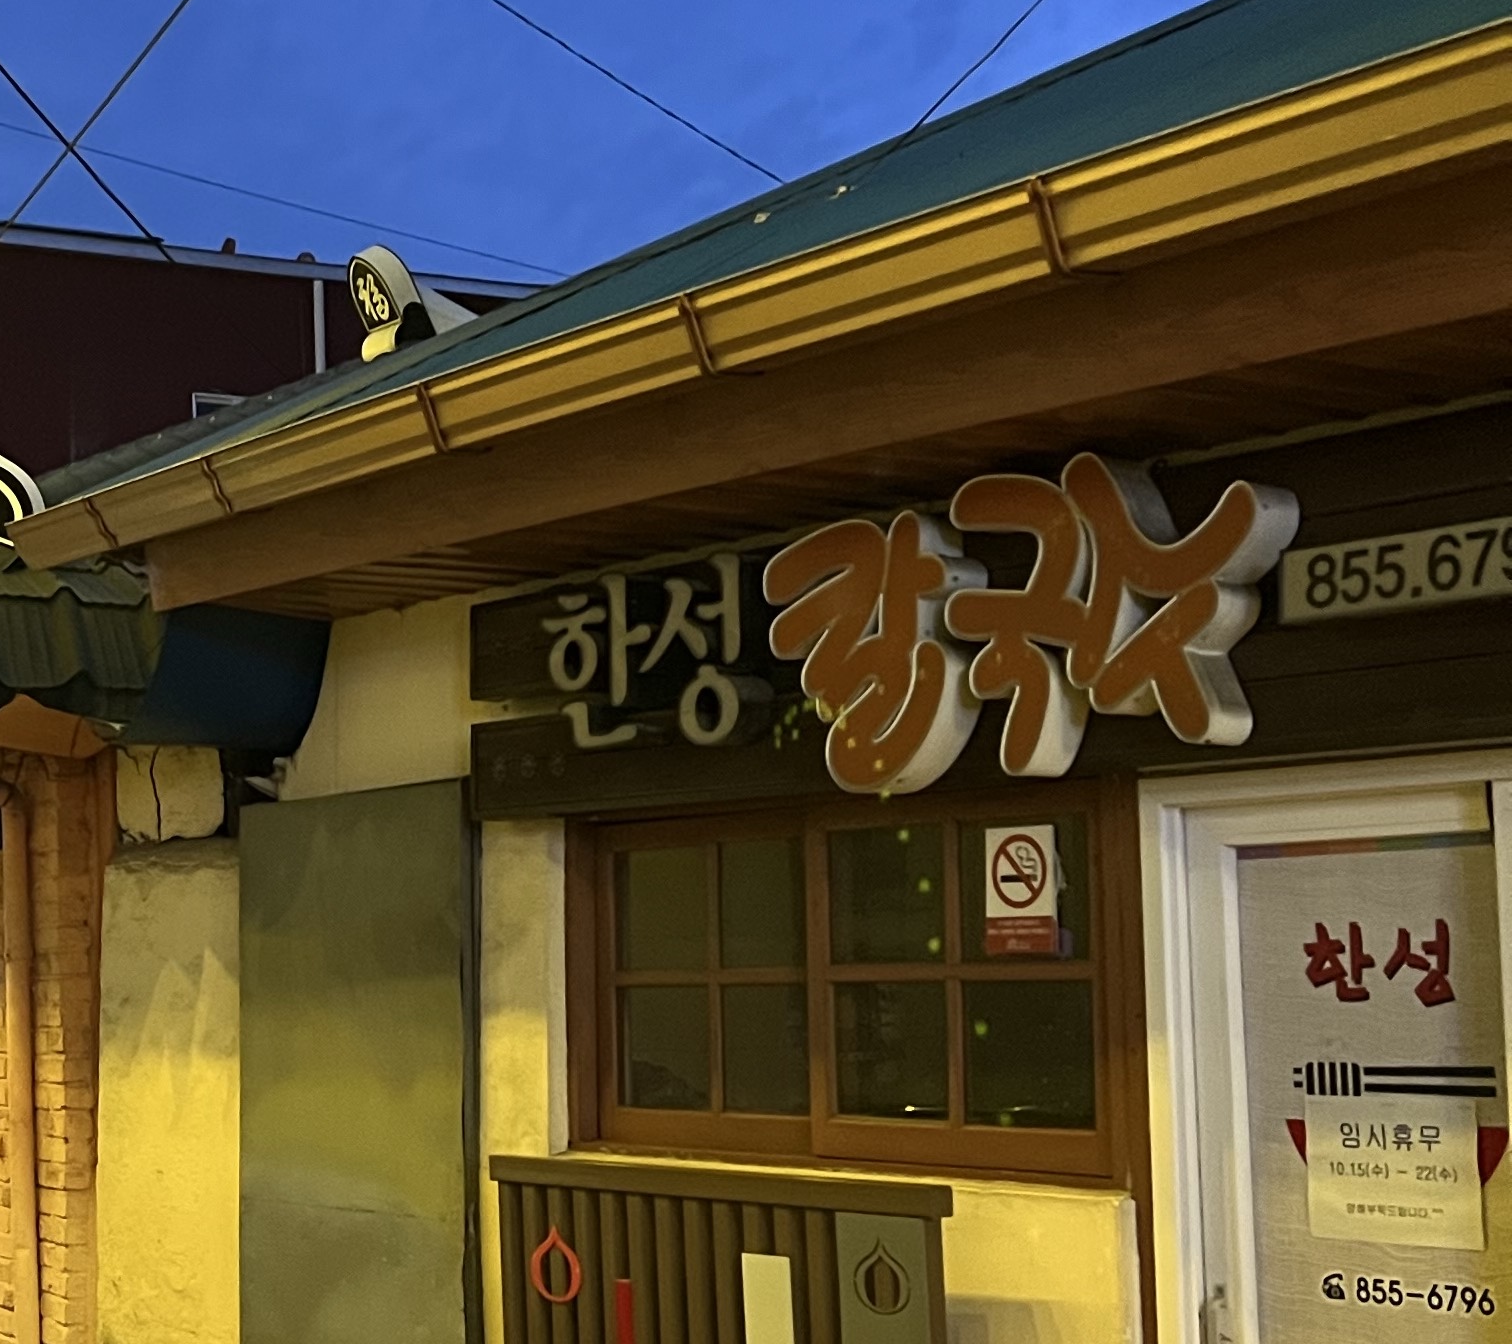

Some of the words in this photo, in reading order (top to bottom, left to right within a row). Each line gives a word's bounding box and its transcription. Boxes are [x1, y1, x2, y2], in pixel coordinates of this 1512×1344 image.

[356, 273, 390, 323] 福
[542, 552, 740, 748] 한성
[763, 452, 1278, 793] 칼국수
[1303, 918, 1456, 1008] 한성
[1339, 1122, 1442, 1151] 임시휴무
[1329, 1161, 1390, 1180] 10.15(수)
[1415, 1165, 1458, 1183] 22(수)
[1356, 1276, 1496, 1316] 855-6796
